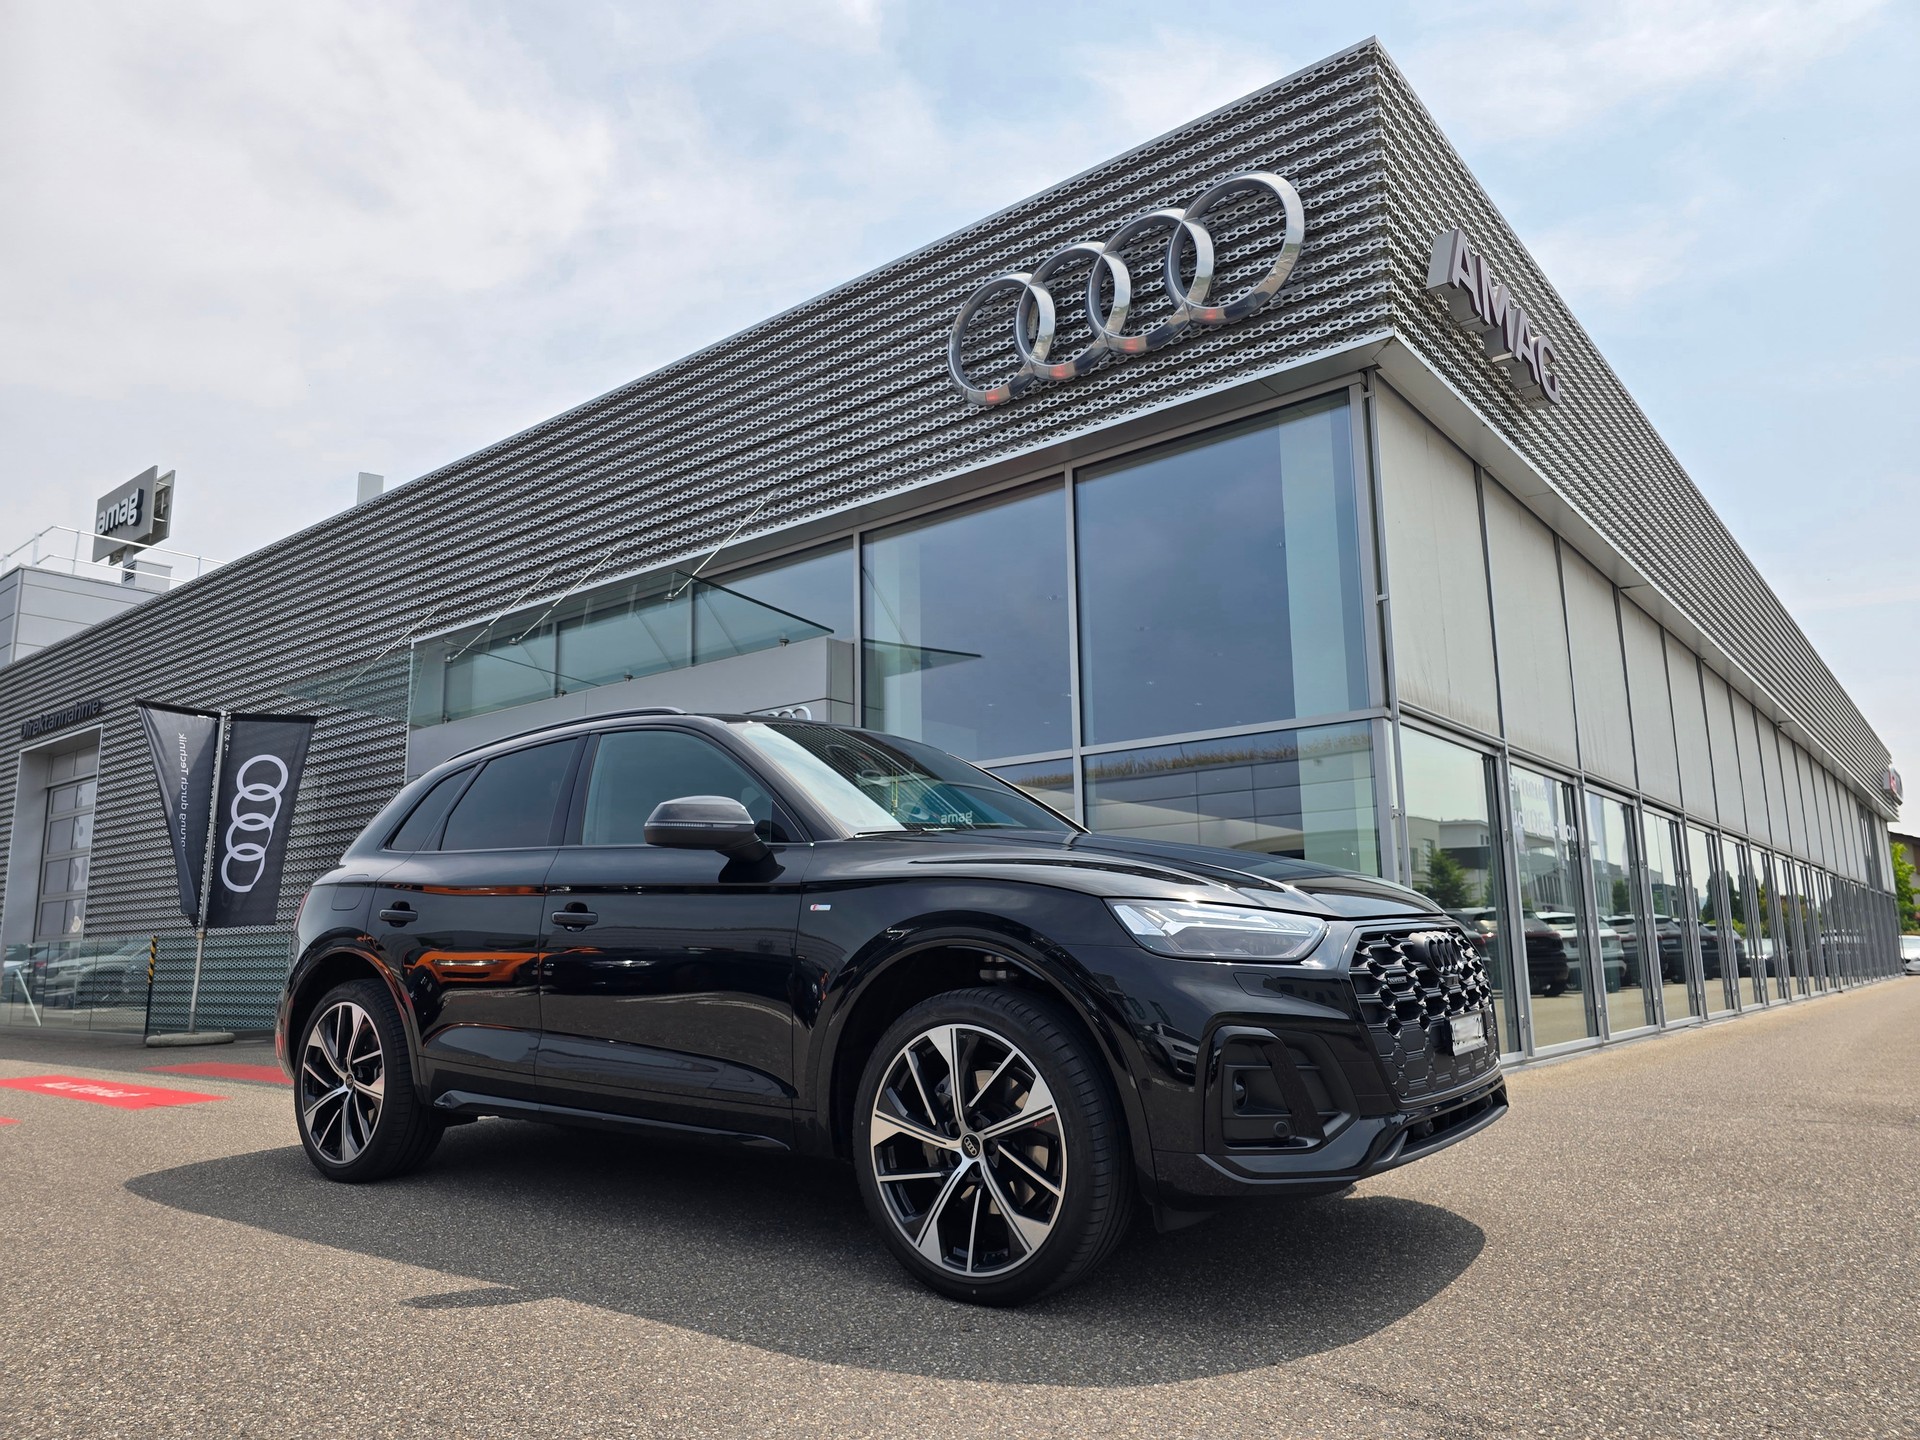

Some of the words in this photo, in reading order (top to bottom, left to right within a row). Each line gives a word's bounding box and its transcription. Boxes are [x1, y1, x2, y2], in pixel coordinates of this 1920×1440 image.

[97, 488, 140, 535] amag
[20, 700, 99, 738] Direktannahme
[940, 810, 973, 825] amag
